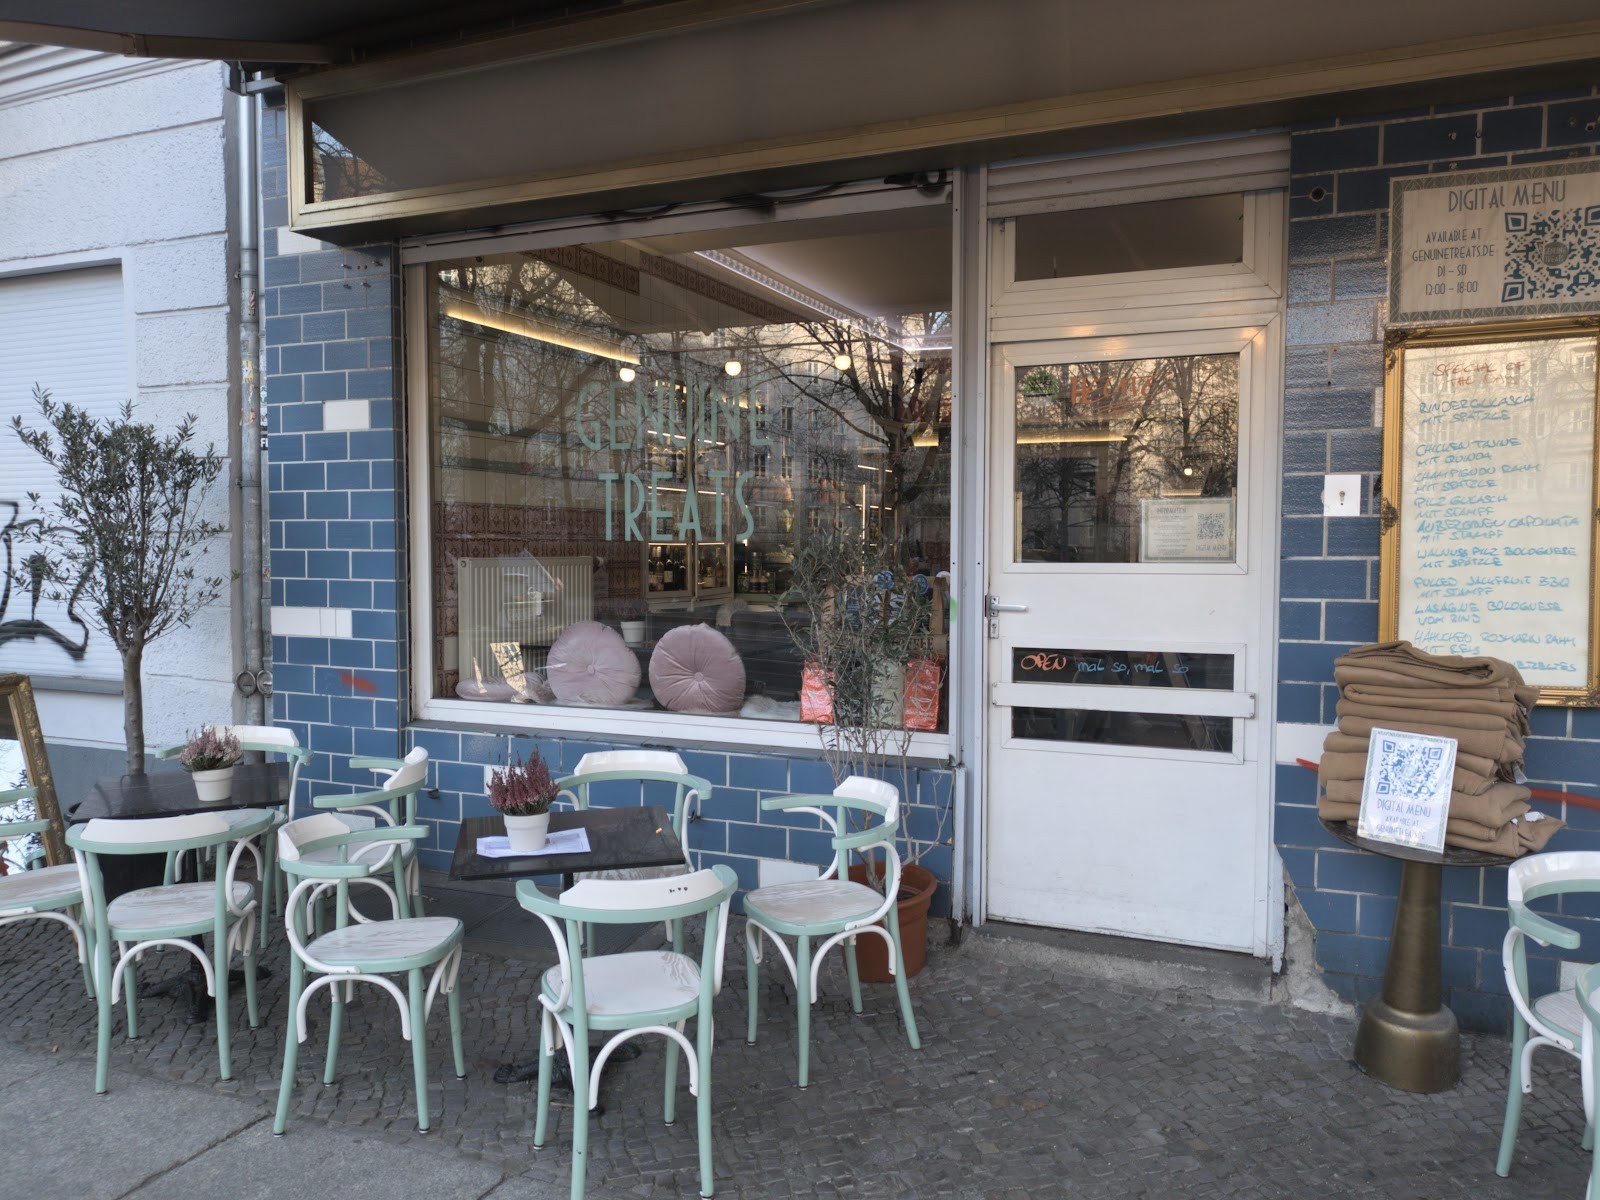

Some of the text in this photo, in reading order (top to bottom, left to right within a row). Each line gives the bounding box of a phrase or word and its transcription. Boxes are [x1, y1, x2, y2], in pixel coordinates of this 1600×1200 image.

[1448, 180, 1567, 212] DIGITAL MENU
[1425, 228, 1483, 244] AVAILABLE AT
[1412, 244, 1495, 262] GENUINETREATS.DE
[1437, 265, 1446, 277] DI
[1457, 264, 1468, 276] SO
[1425, 283, 1446, 296] 12:00
[1456, 281, 1479, 293] 18:00
[1432, 361, 1526, 377] SPECIAL OF
[1447, 376, 1474, 387] THE
[576, 373, 774, 450] GENUINE
[1421, 414, 1446, 426] MIT
[1415, 441, 1469, 457] CHICKEN
[1417, 452, 1492, 468] MIT QUINOA
[1415, 482, 1440, 495] MIT
[598, 471, 755, 542] TREATS
[1414, 496, 1447, 508] PILZ
[1415, 509, 1443, 520] MIT
[1420, 532, 1441, 543] MIT
[1472, 546, 1500, 556] PILZ
[1504, 546, 1578, 557] BOLOGNESE
[1419, 560, 1444, 570] MIT
[1414, 577, 1457, 588] PULLED
[1466, 575, 1532, 586] JACKFRUIT
[1417, 587, 1495, 599] MIT STAMPF
[1414, 601, 1564, 615] LASAGNE BOLOGNESE
[1418, 614, 1480, 626] VOM RIND
[1546, 633, 1576, 647] RAHM
[1021, 653, 1067, 671] OPEN
[1172, 664, 1190, 674] so
[1377, 798, 1431, 817] DIGITAL MENU
